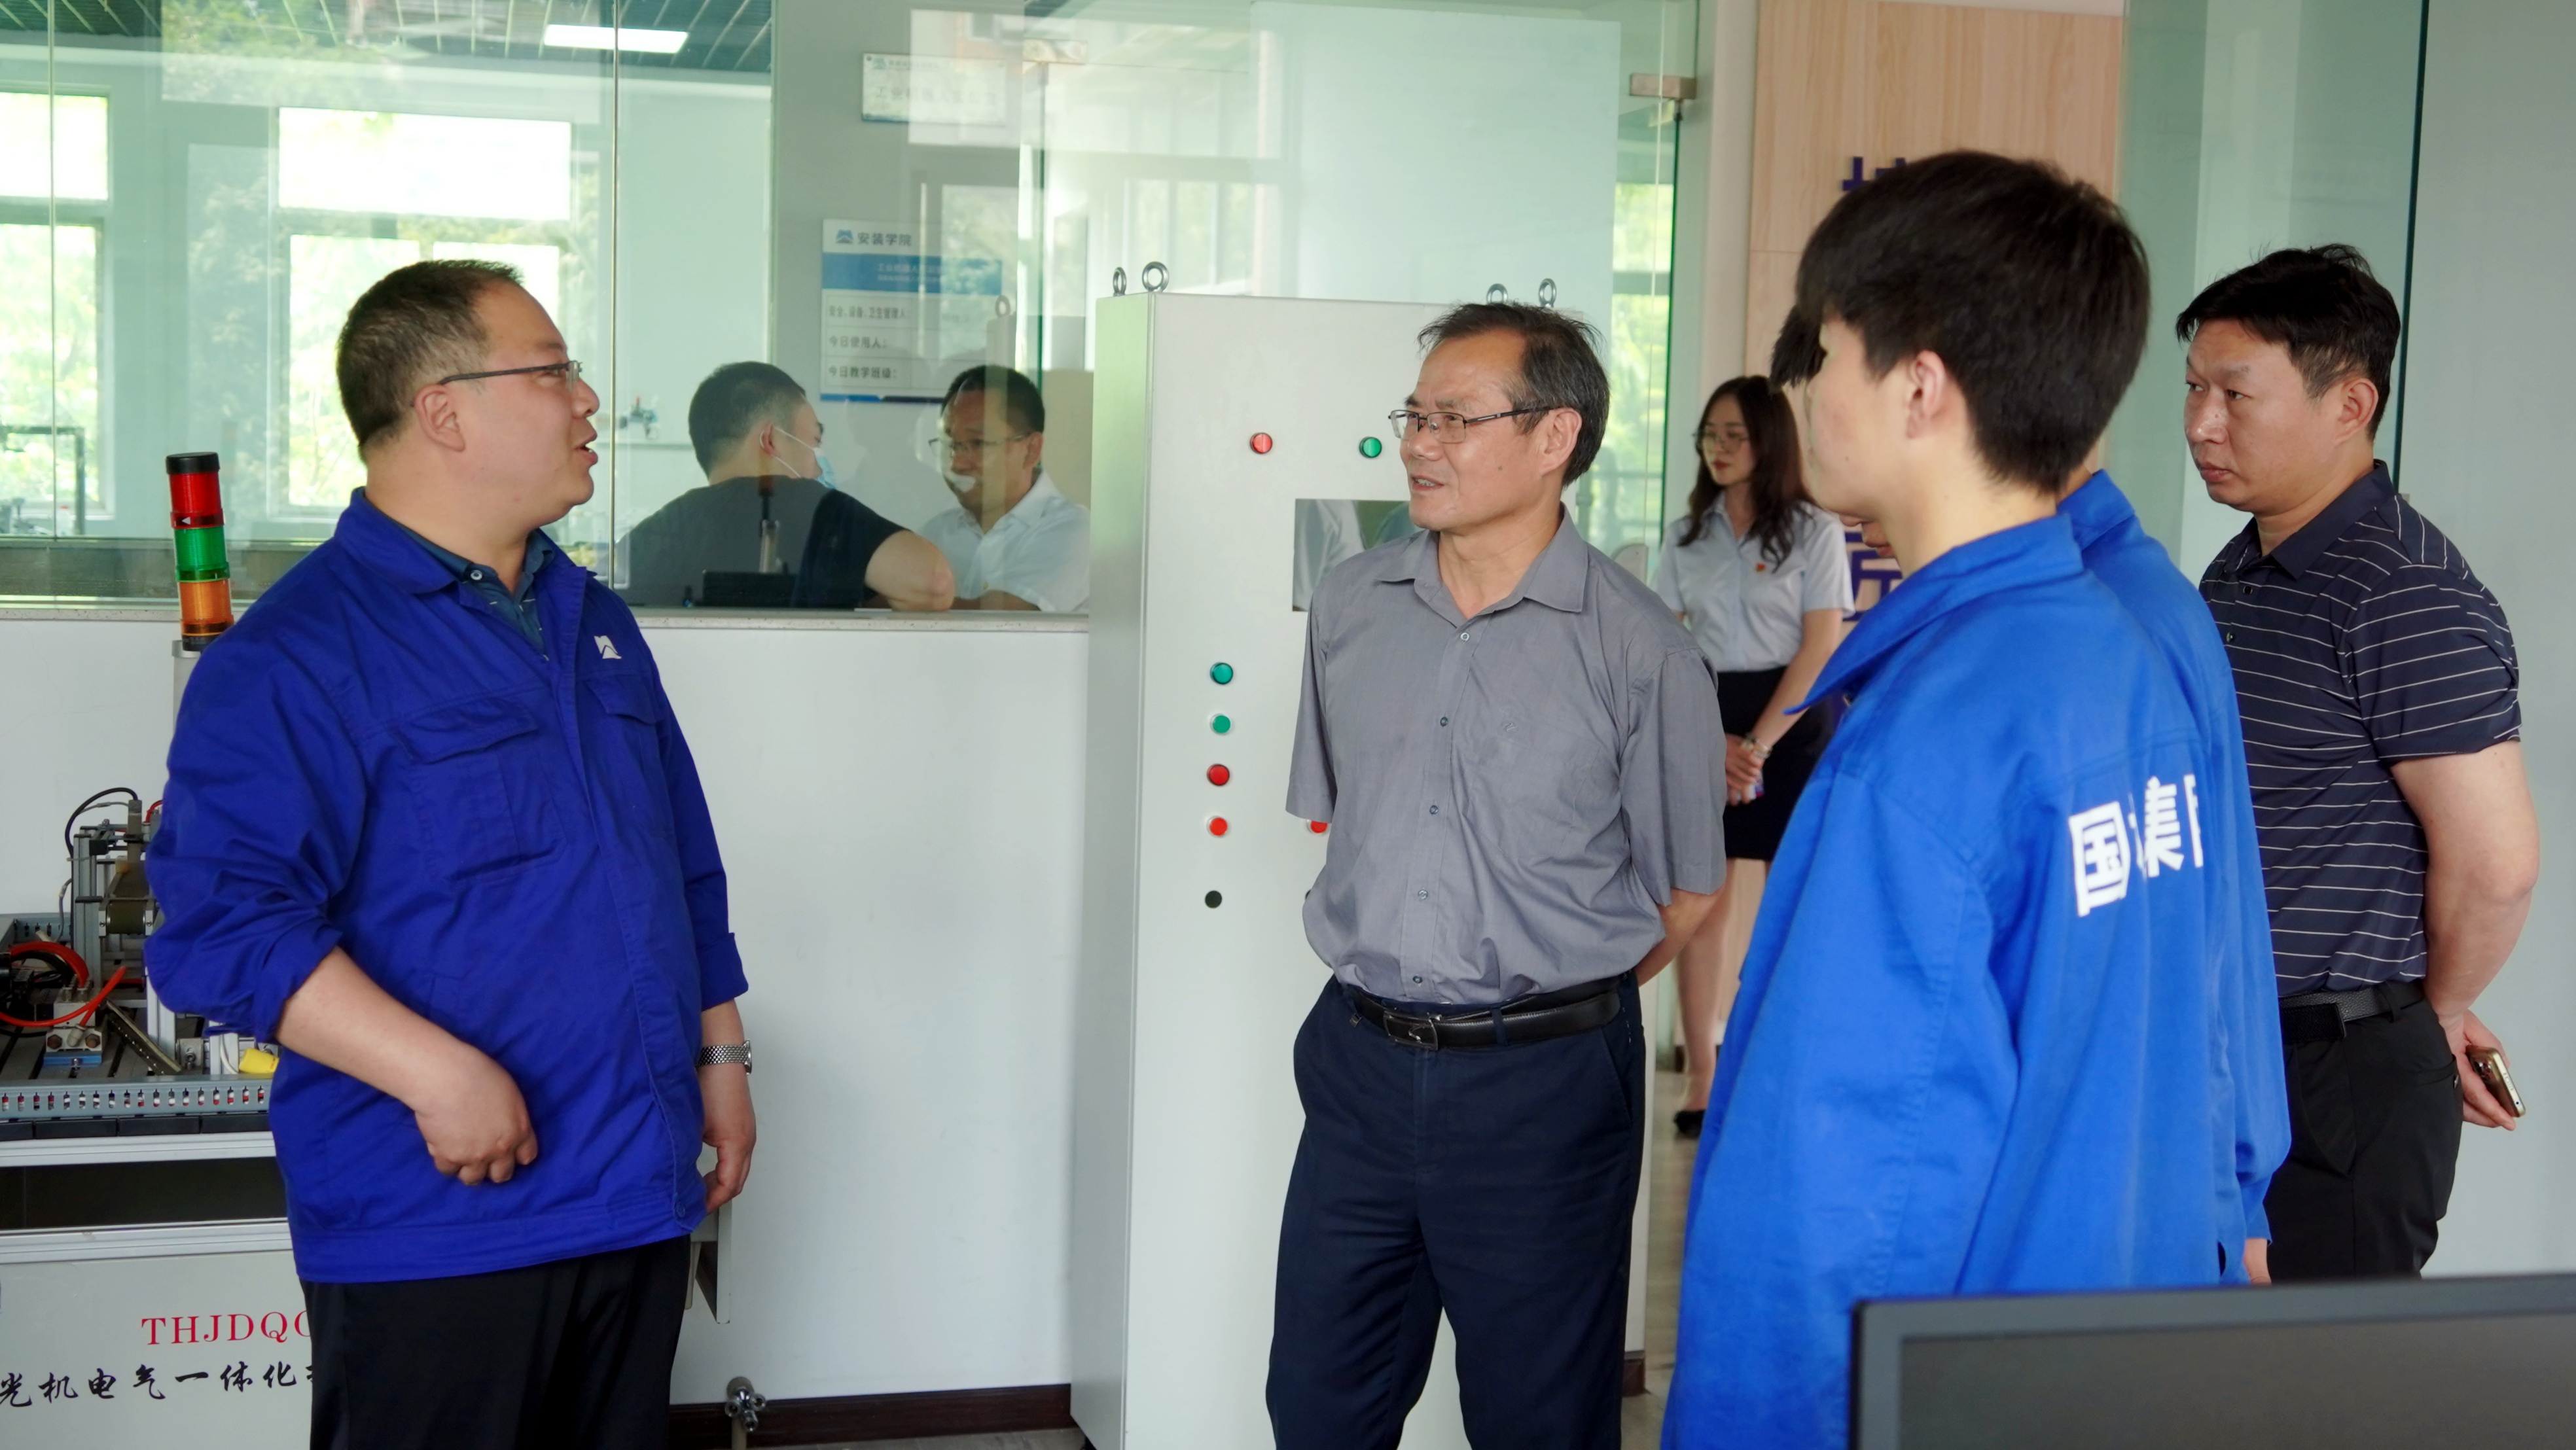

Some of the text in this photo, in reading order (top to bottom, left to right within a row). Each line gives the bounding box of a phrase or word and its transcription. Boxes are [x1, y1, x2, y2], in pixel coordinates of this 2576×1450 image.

[857, 232, 912, 246] 安装学院
[829, 335, 886, 348] 今日使用人：
[829, 365, 897, 379] 今日教学班级：
[2069, 773, 2204, 917] 国集
